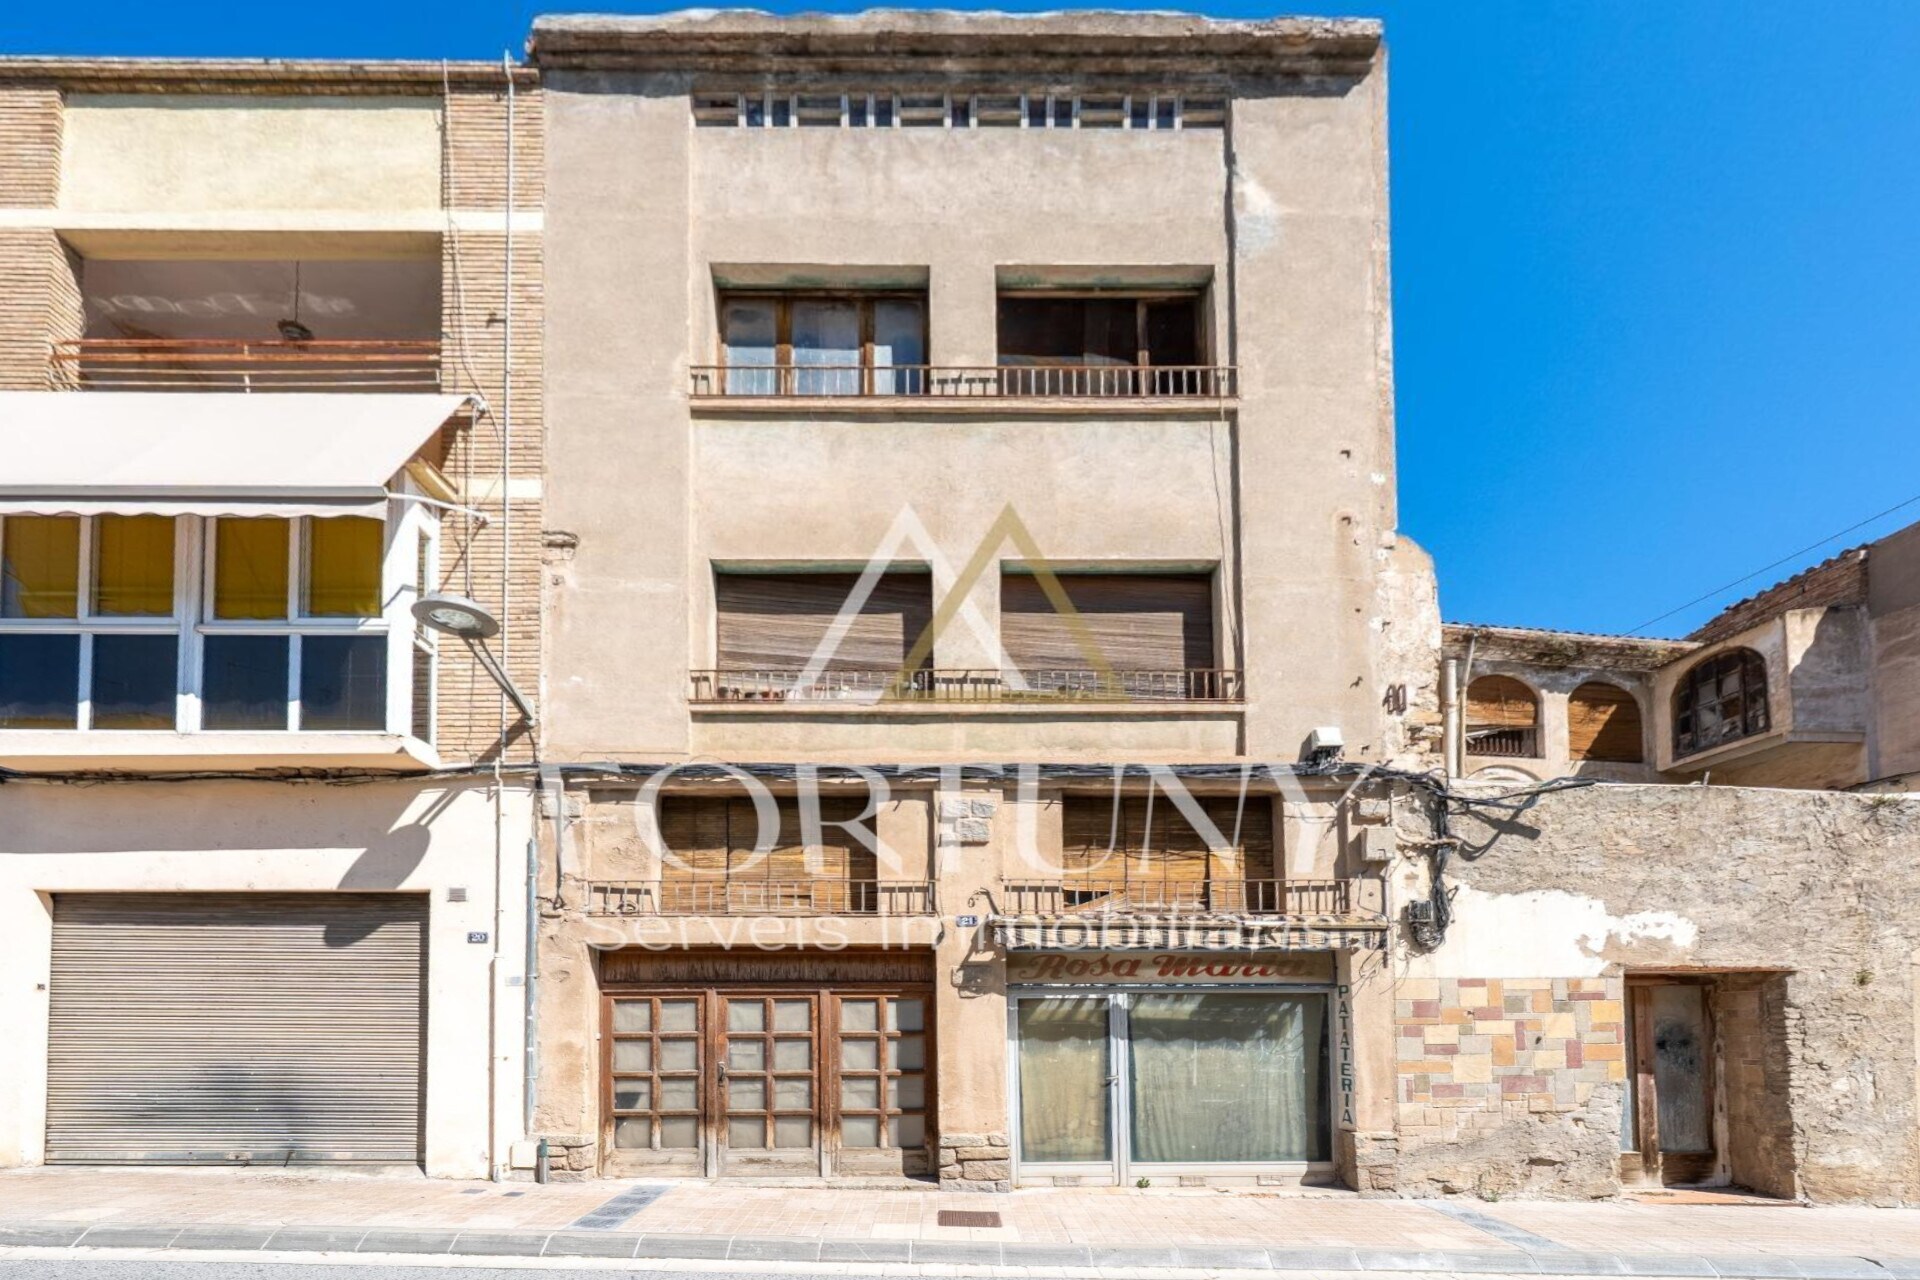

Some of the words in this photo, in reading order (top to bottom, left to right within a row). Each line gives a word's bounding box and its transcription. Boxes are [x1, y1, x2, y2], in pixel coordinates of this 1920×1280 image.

[469, 932, 486, 943] 20
[1018, 953, 1139, 980] Rosa
[1338, 984, 1353, 1125] PATATERIA
